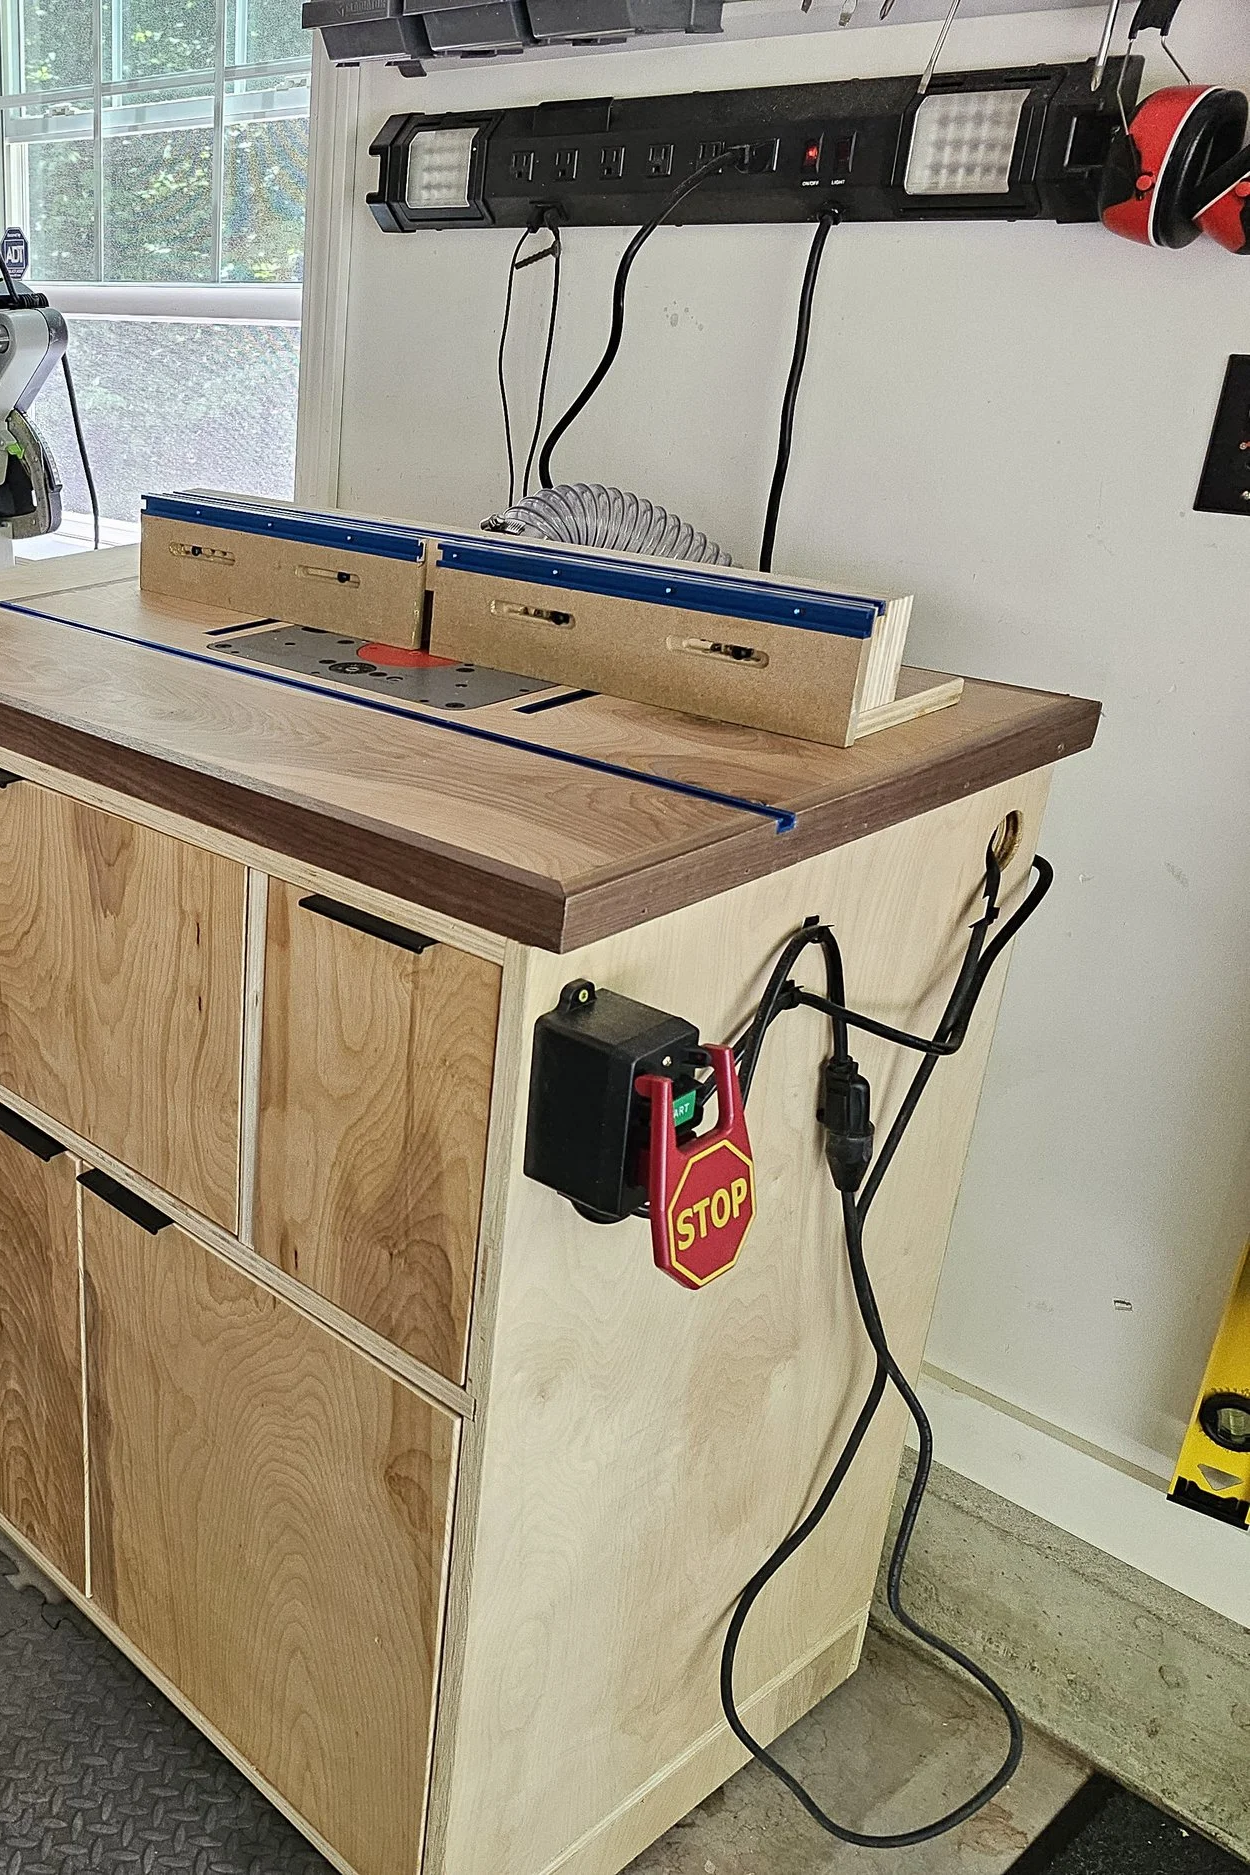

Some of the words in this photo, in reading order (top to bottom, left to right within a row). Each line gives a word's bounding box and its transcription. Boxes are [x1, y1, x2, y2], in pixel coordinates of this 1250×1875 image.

[6, 245, 23, 264] ADT
[673, 1102, 691, 1119] ART
[675, 1177, 748, 1252] STOP
